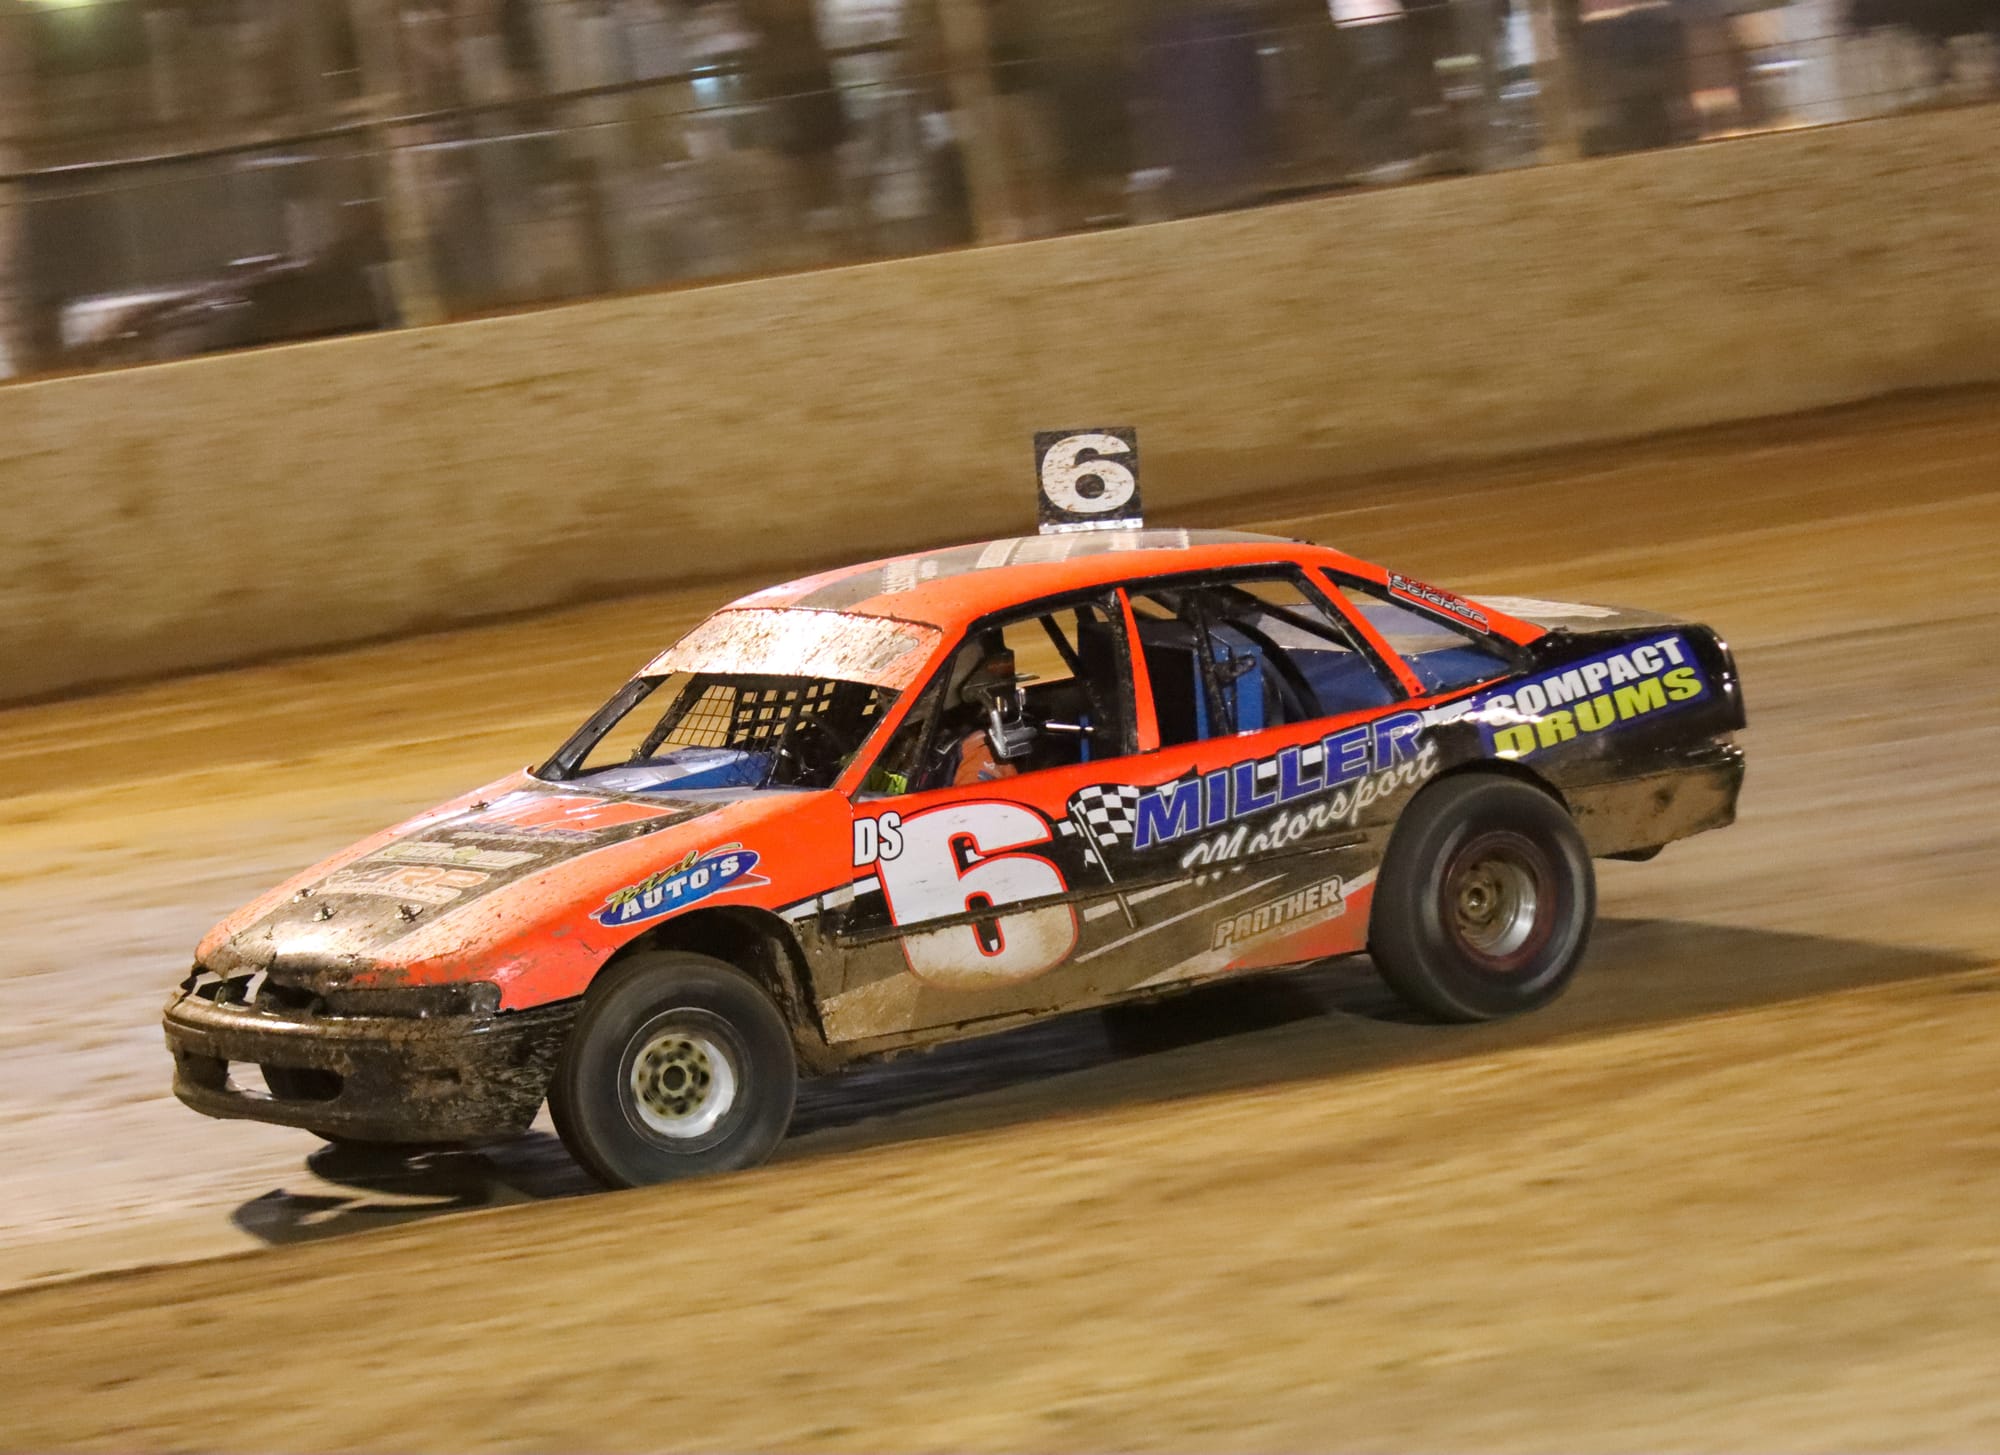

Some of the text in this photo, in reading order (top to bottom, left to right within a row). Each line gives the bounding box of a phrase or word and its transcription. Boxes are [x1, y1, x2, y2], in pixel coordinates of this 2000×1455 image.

[1042, 433, 1135, 513] 6
[1485, 637, 1685, 726] COMPACT
[1494, 667, 1703, 760] DRUMS
[1132, 710, 1426, 851] MILLER
[1181, 740, 1440, 887] Motorsport
[853, 811, 904, 868] DS
[620, 855, 741, 921] AUTO'S
[876, 799, 1078, 991] 6
[1213, 878, 1342, 950] PANTHER
